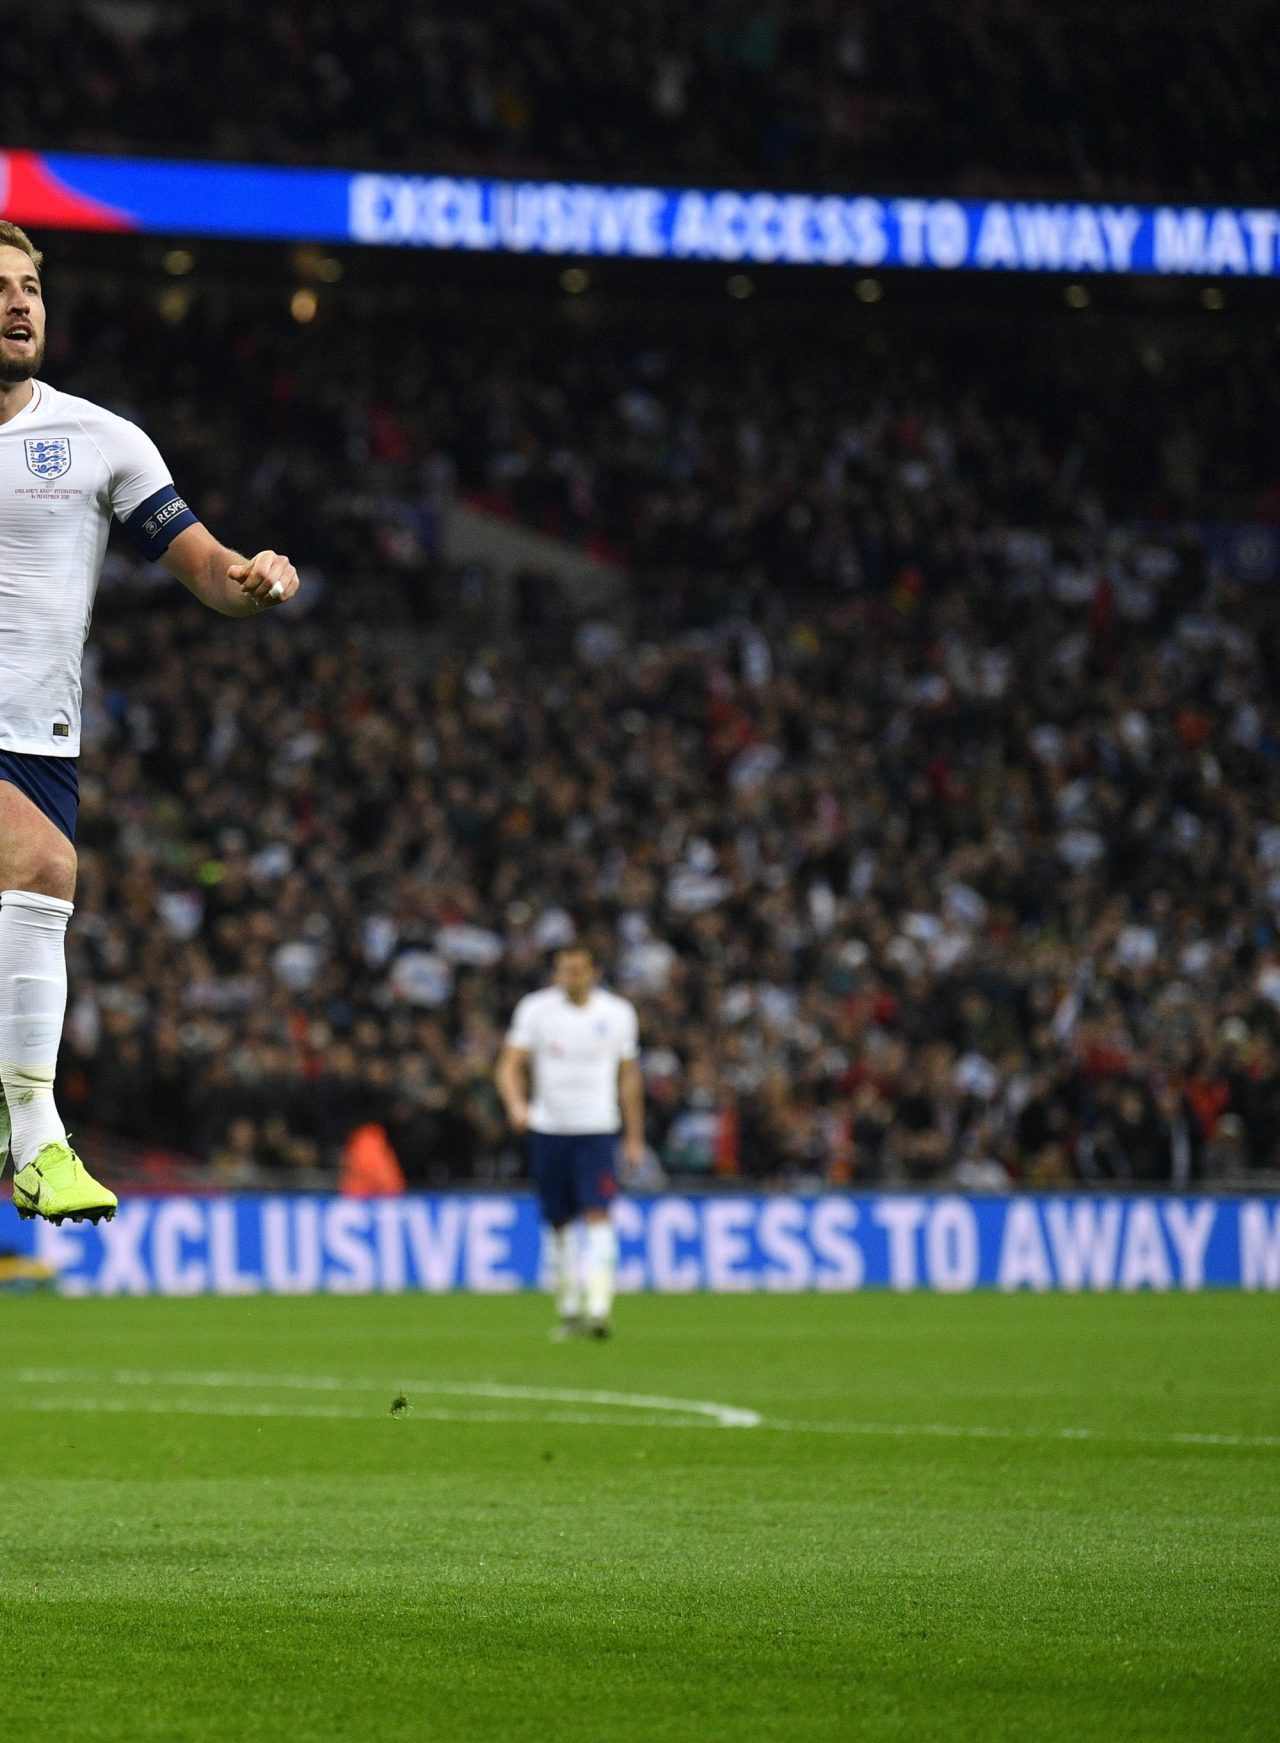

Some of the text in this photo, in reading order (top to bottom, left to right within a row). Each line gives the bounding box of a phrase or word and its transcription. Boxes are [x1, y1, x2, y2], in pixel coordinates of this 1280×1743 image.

[348, 172, 1280, 276] EXCLUSIVE ACCESS TO AWAY MAT
[36, 1197, 519, 1297] EXCLUSIVE
[539, 1197, 866, 1294] CCESS
[872, 1197, 980, 1294] TO
[995, 1198, 1216, 1294] AWAY
